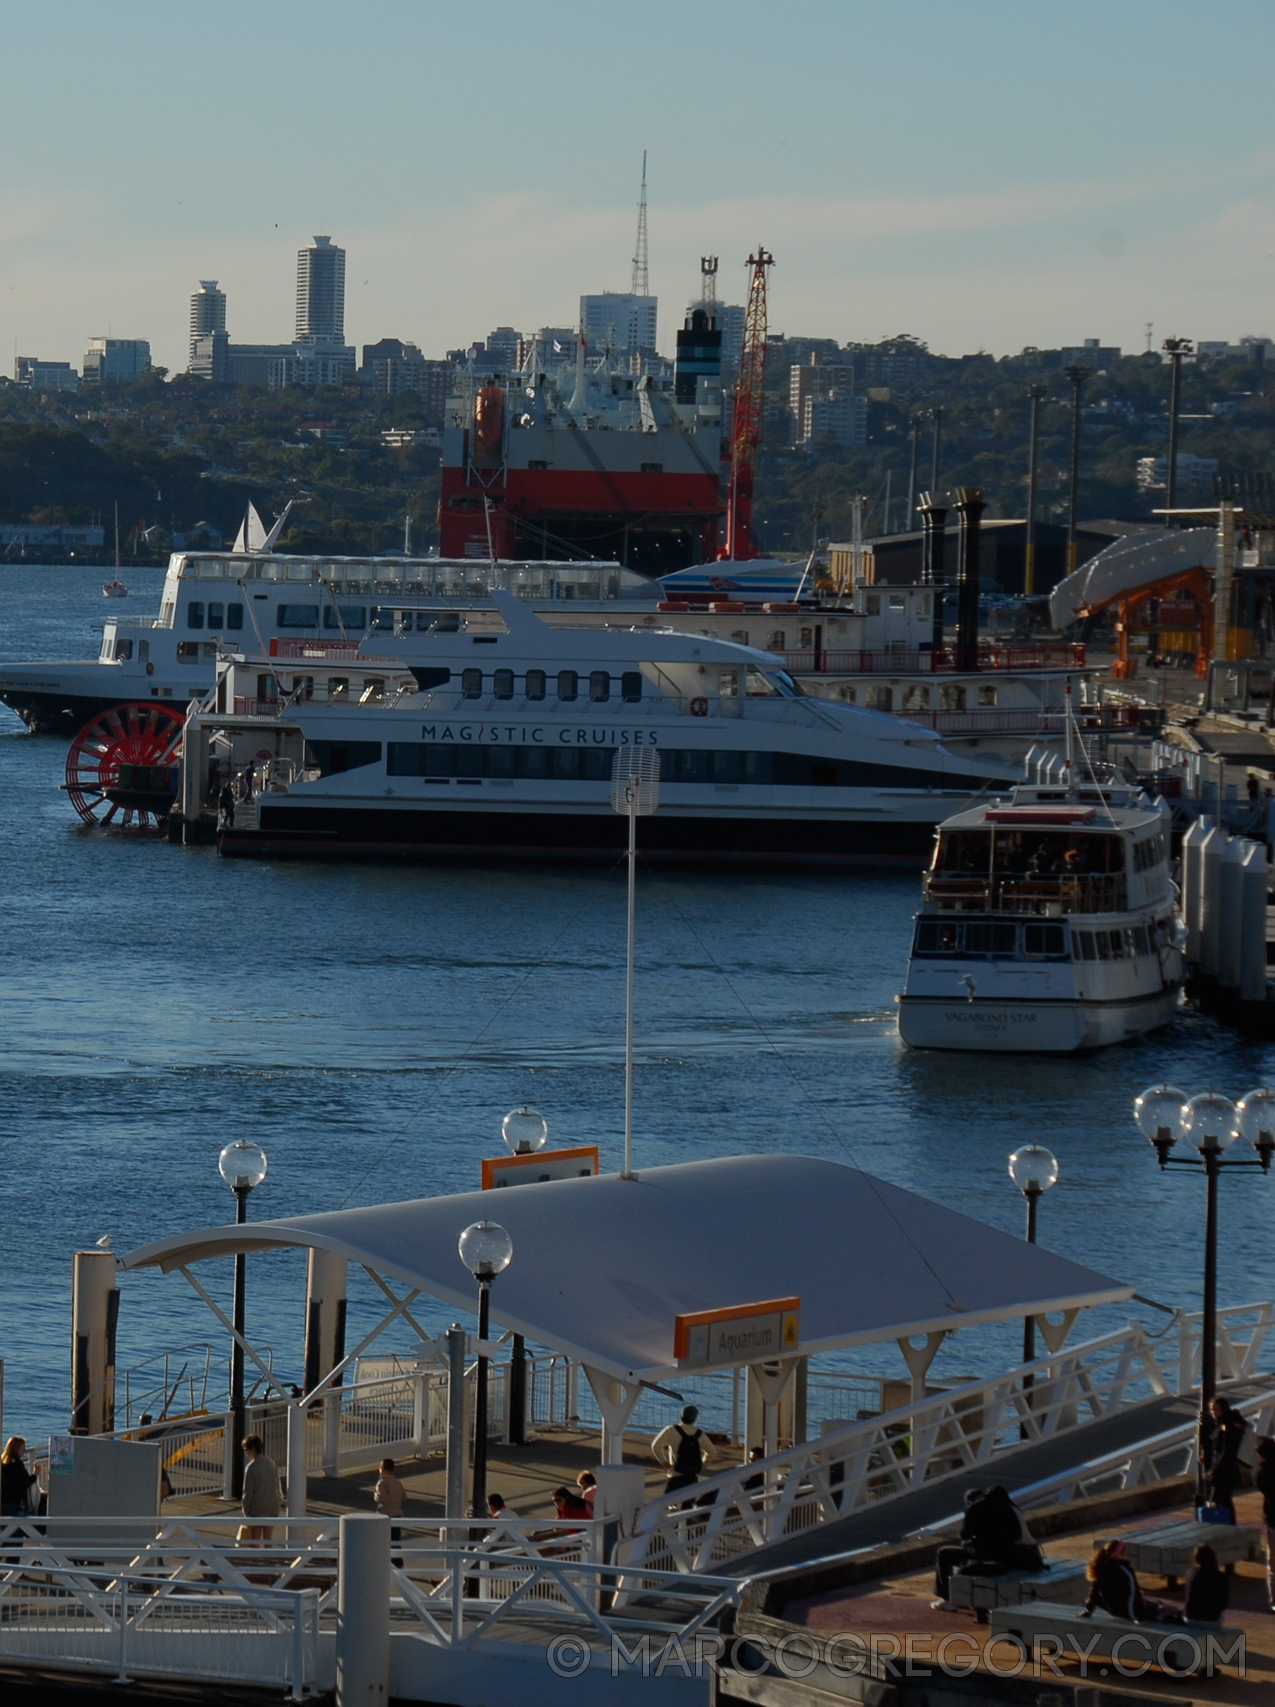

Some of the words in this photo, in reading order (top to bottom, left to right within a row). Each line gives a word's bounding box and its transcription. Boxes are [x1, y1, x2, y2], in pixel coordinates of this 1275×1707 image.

[421, 723, 544, 743] MAGISTIC
[559, 728, 658, 745] CRUISES
[944, 1012, 1007, 1023] VAGABOND
[1010, 1013, 1038, 1024] STAR
[719, 1326, 773, 1356] Aquarium
